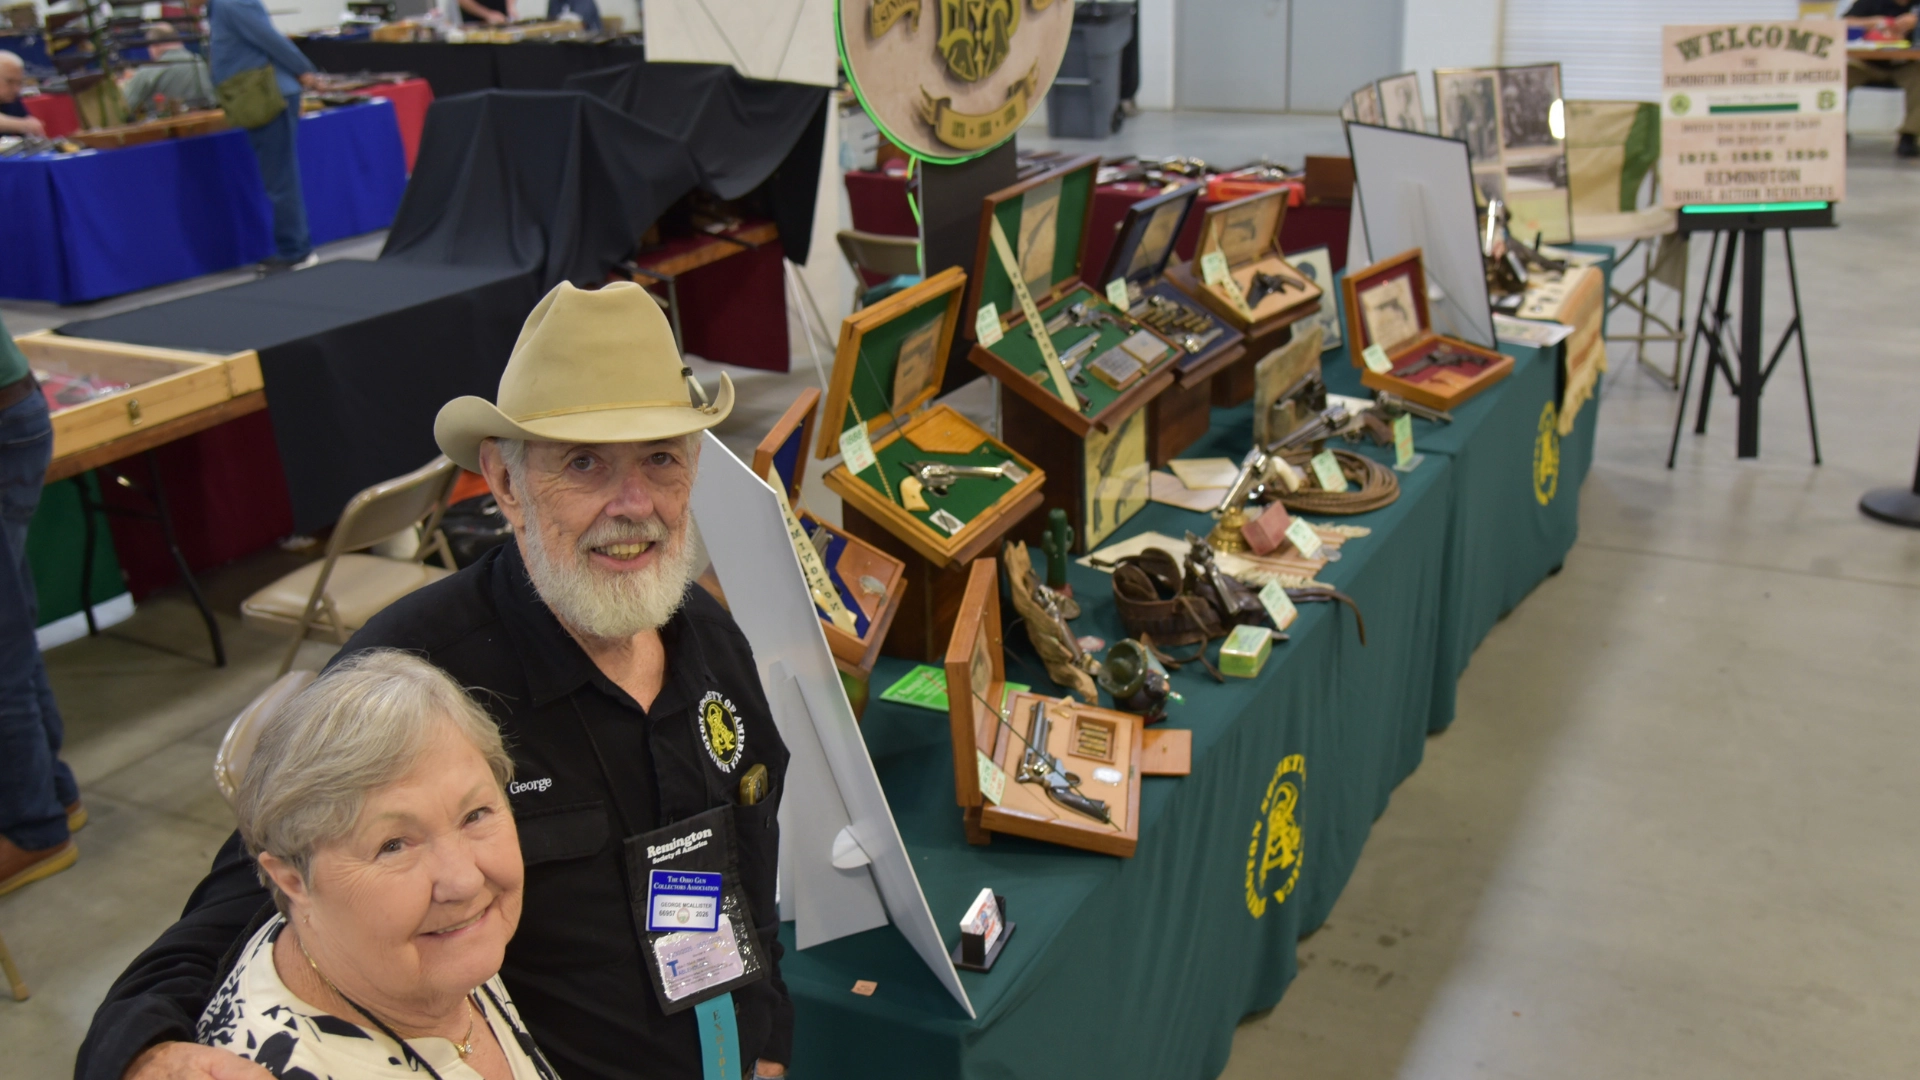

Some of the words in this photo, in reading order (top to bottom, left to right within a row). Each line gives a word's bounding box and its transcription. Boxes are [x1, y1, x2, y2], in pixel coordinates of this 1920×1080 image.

[1675, 25, 1834, 62] WELCOME
[509, 777, 553, 795] George
[646, 828, 713, 859] Remington
[652, 852, 675, 865] Society
[682, 840, 708, 854] America
